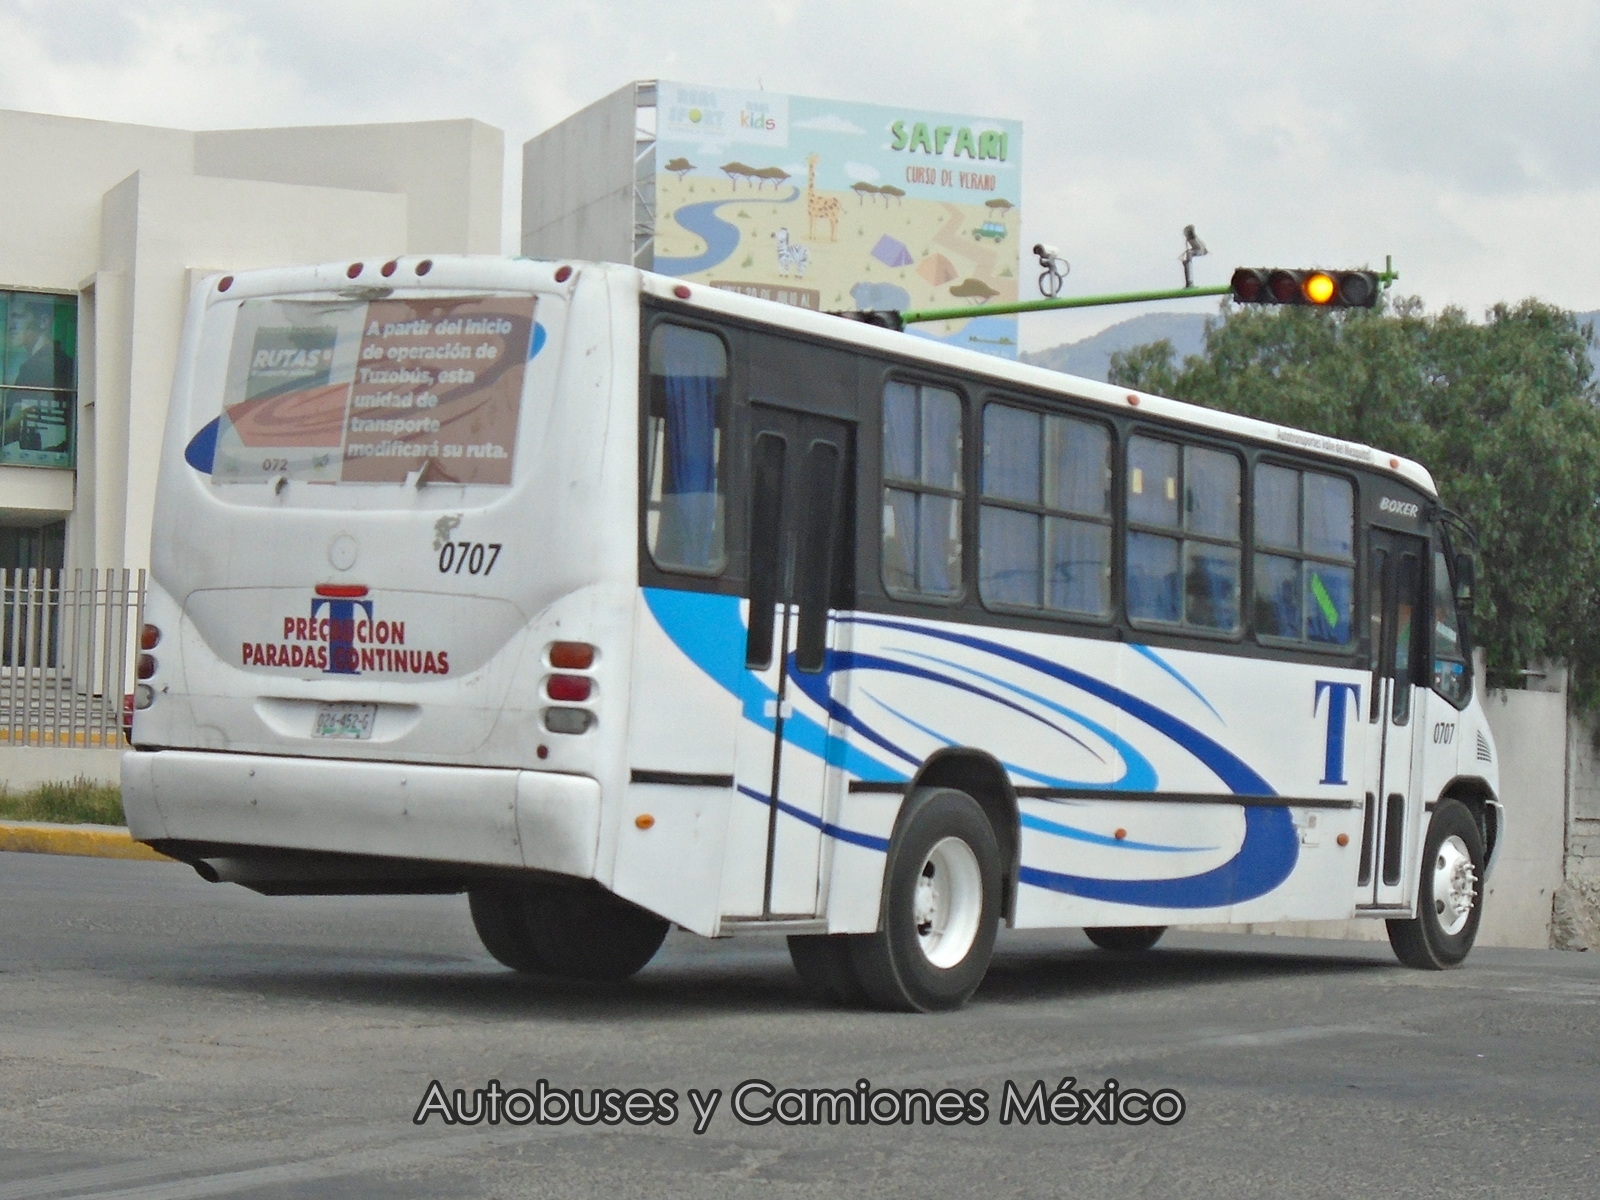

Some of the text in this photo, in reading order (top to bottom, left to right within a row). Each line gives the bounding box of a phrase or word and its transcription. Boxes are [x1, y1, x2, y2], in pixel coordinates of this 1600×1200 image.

[739, 110, 777, 131] kids
[890, 120, 1010, 162] SAFARI
[905, 165, 997, 191] CURSO DE VERANO
[366, 318, 513, 339] A partir del inicio
[253, 349, 320, 368] RUTAS
[362, 342, 498, 363] de operación de
[359, 366, 475, 386] Tuzobús, esta
[353, 391, 439, 407] unidad de
[350, 417, 441, 434] transporte
[347, 441, 509, 459] modificará su ruta.
[262, 459, 289, 472] 072
[1379, 496, 1419, 518] BOXER
[438, 541, 502, 576] 0707
[242, 642, 450, 675] PARADAS CONTINUAS
[1313, 680, 1362, 785] T
[1433, 722, 1456, 744] 0707
